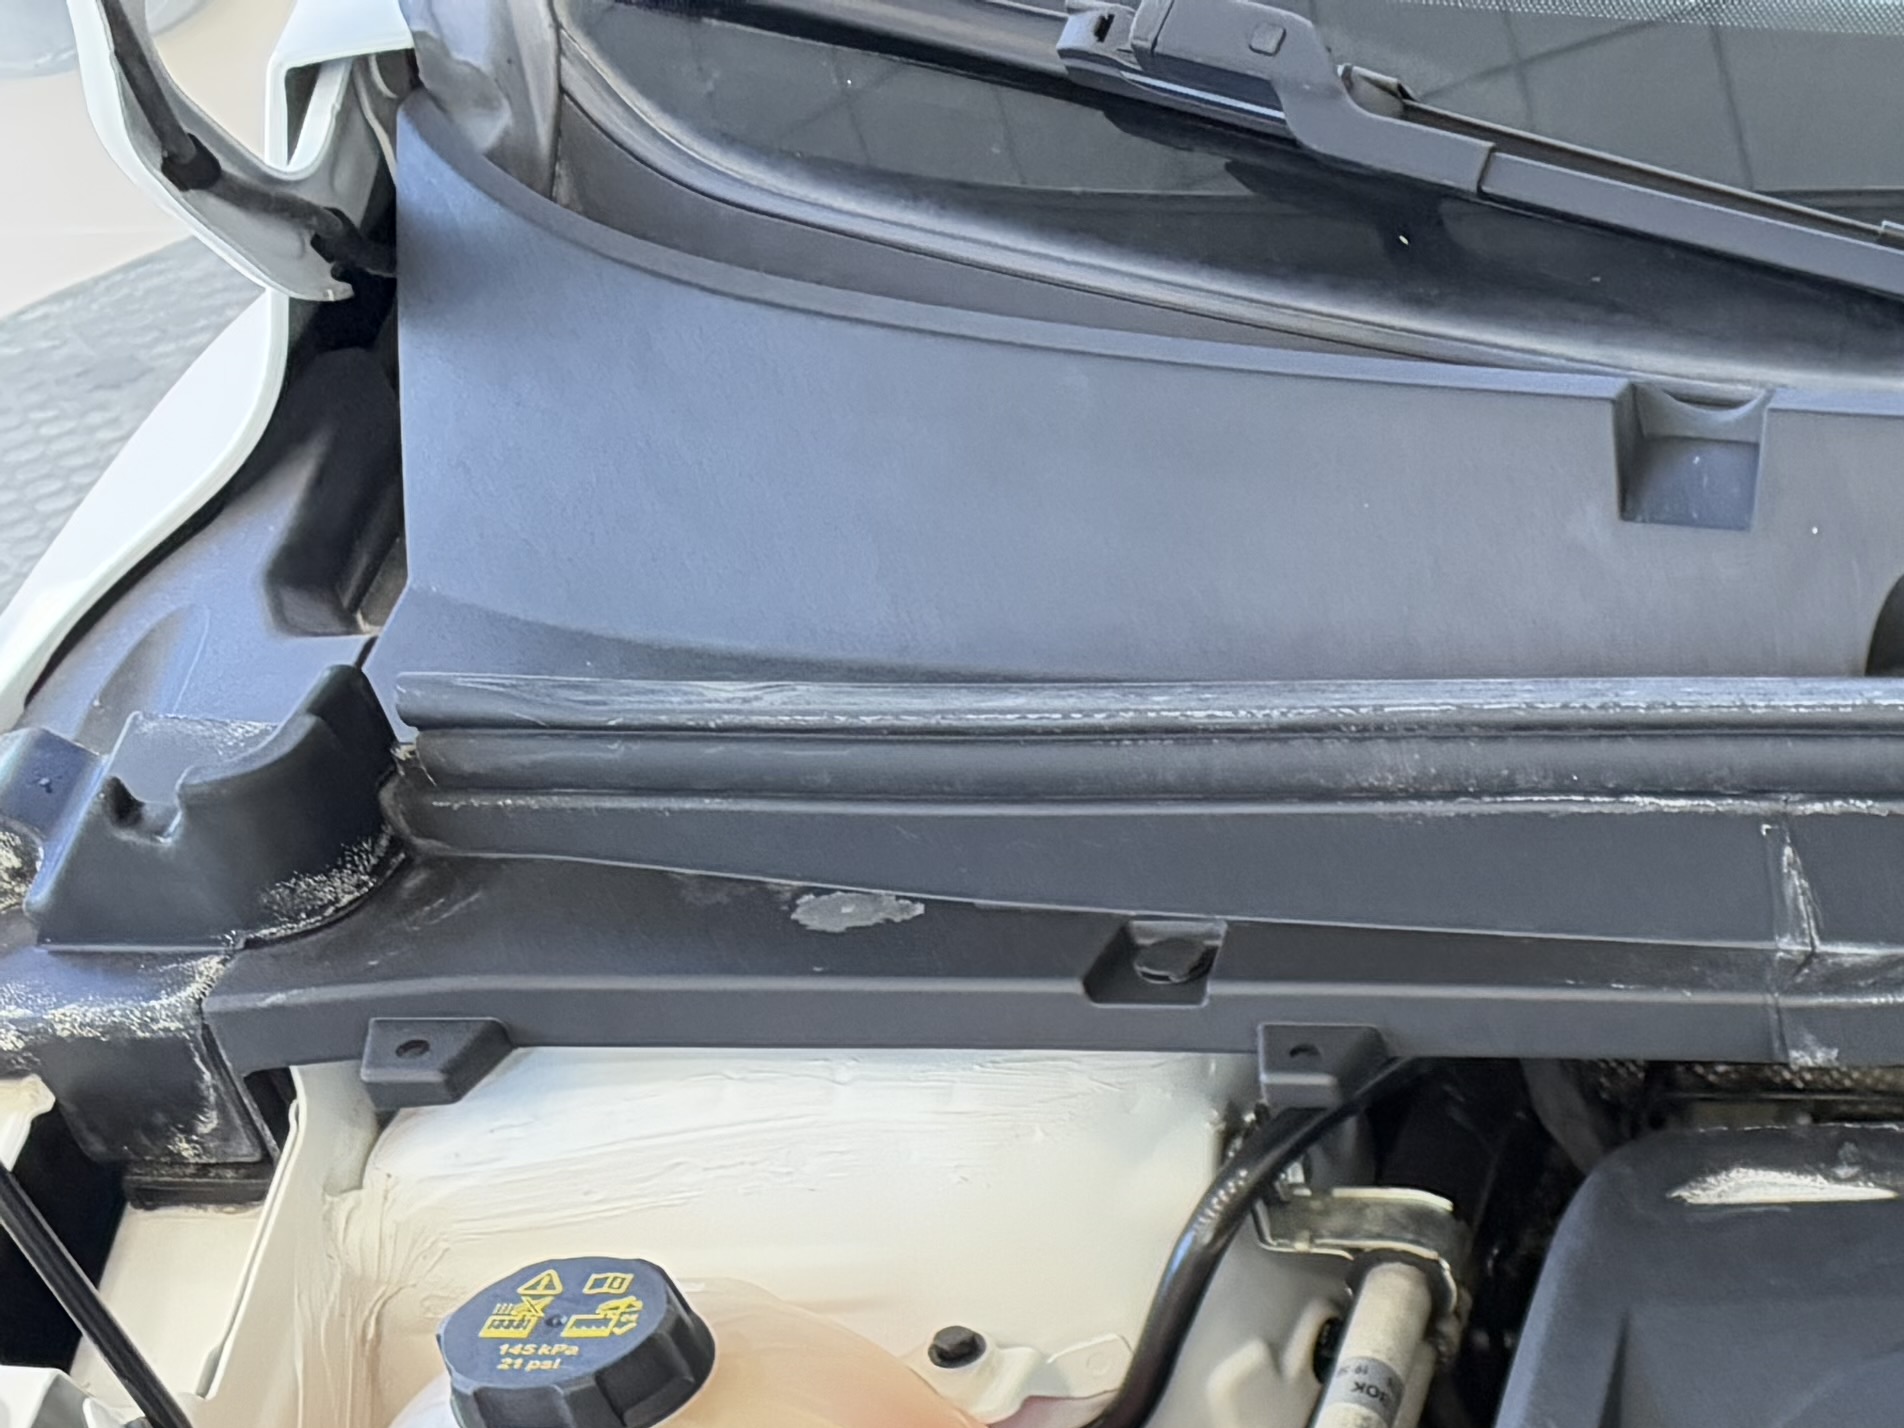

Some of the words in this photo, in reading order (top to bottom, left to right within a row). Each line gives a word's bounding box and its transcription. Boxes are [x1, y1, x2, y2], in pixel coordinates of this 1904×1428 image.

[538, 1343, 580, 1356] kPa
[496, 1357, 524, 1371] 21
[525, 1357, 562, 1373] psi
